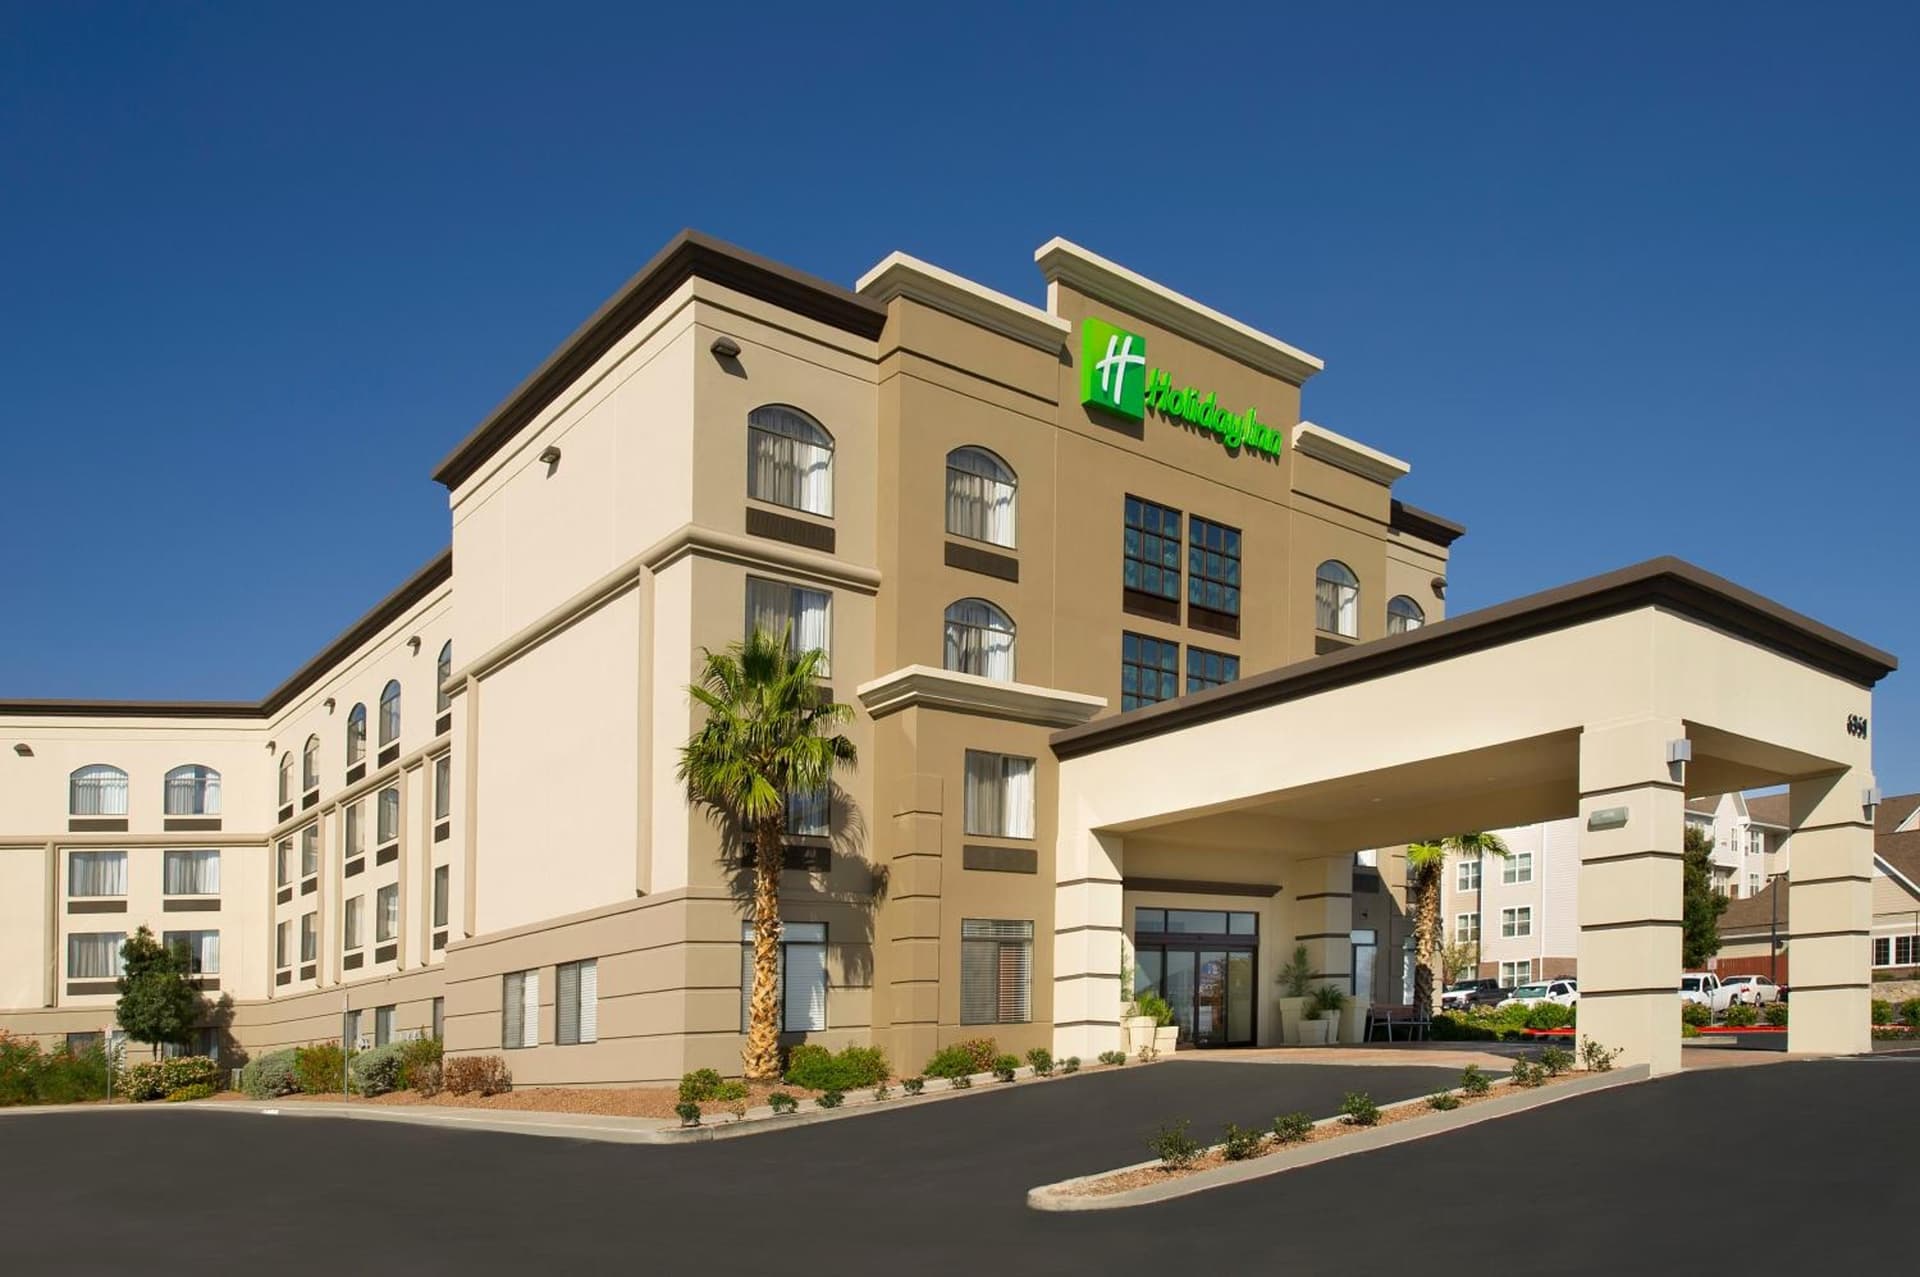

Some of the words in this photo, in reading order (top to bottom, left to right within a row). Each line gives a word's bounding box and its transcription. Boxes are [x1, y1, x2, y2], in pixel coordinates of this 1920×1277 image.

[1095, 334, 1145, 405] H
[1145, 368, 1244, 448] Holiday
[1241, 407, 1283, 456] Inn
